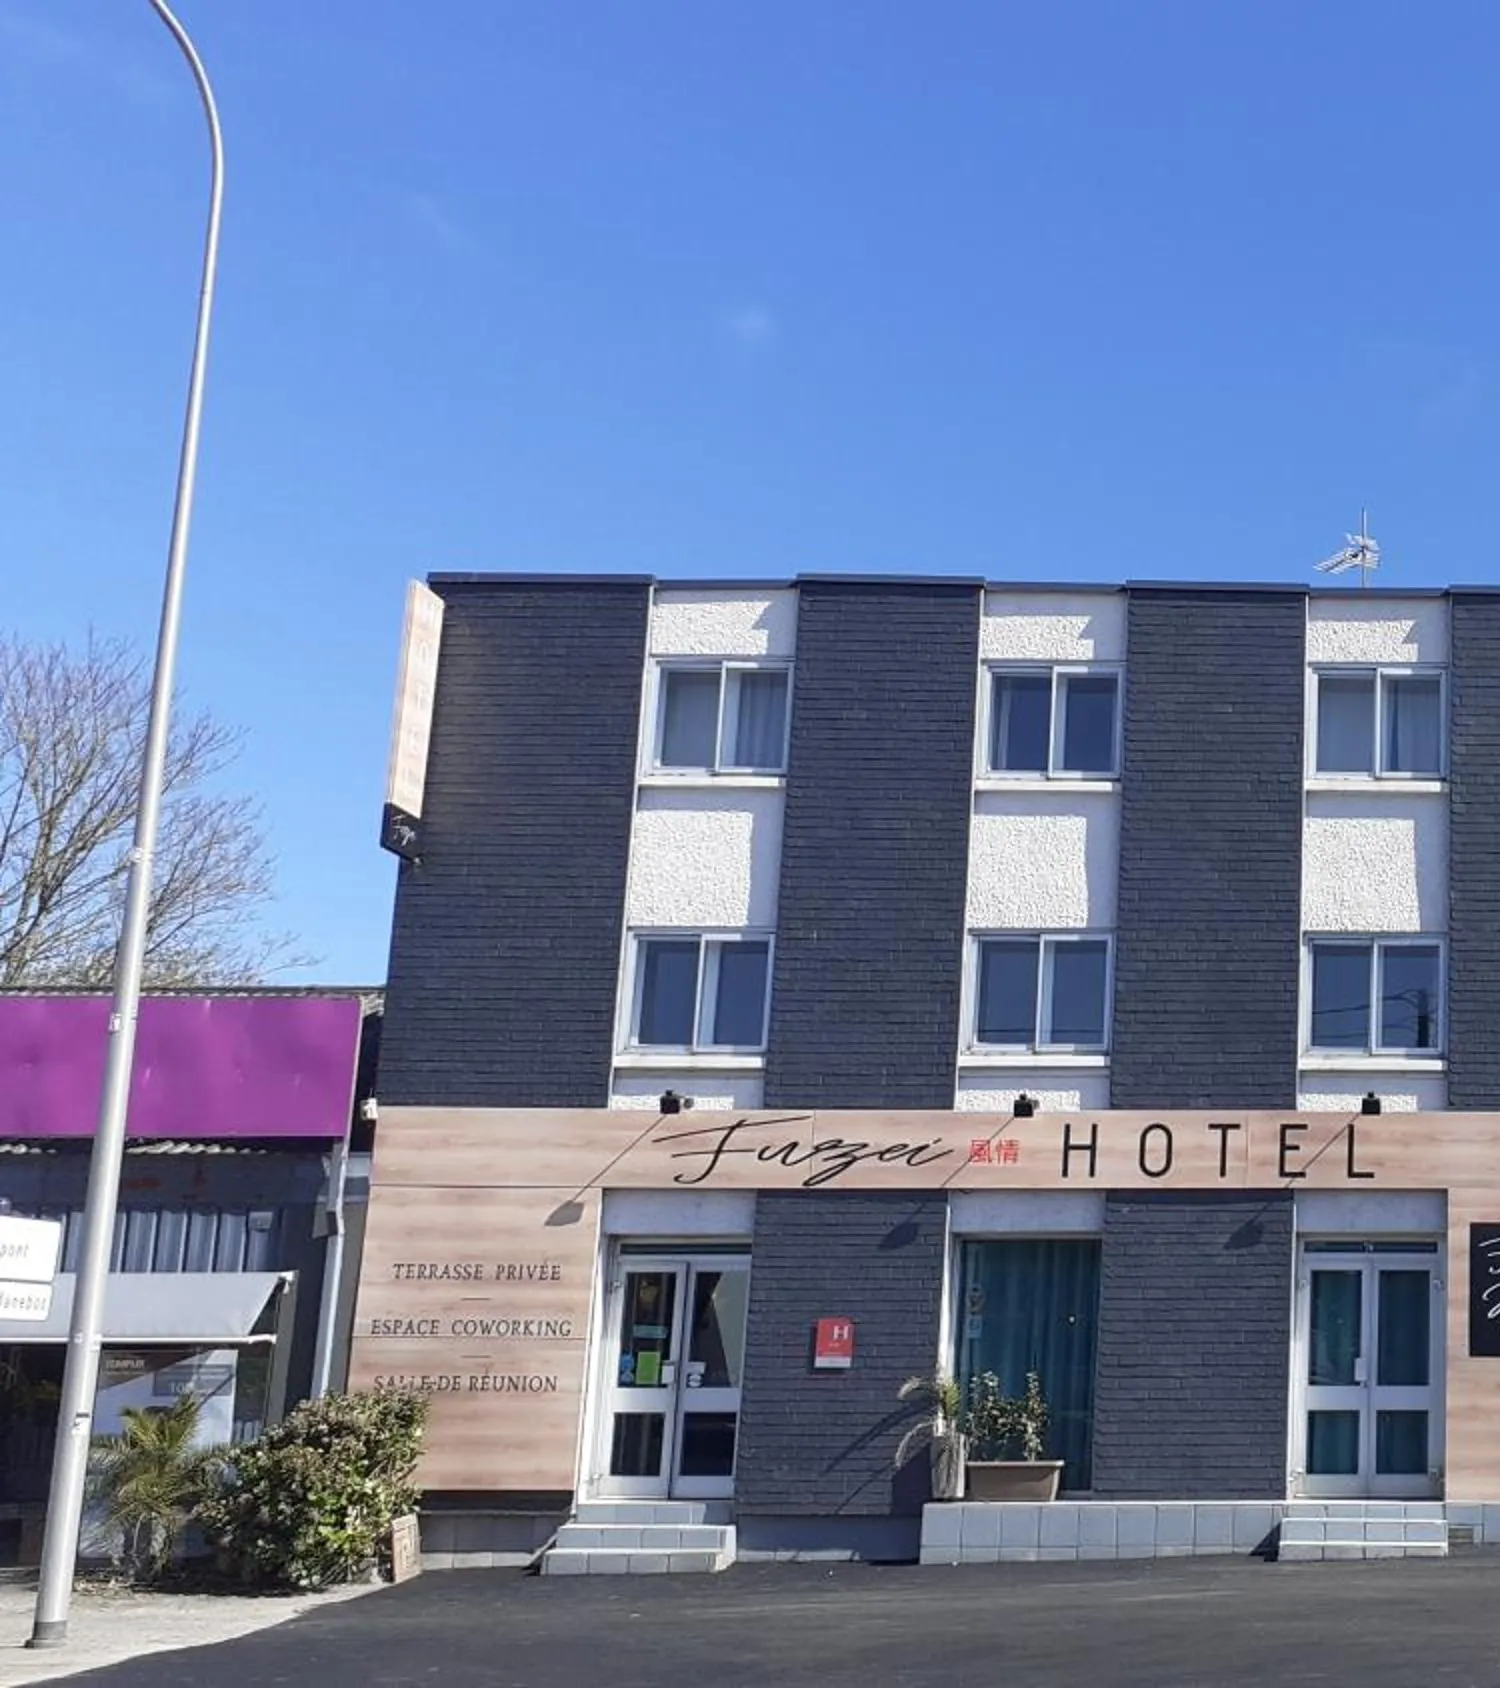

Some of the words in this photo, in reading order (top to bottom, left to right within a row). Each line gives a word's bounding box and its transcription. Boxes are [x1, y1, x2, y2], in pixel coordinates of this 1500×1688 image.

[652, 1115, 954, 1187] Fuzei
[1061, 1123, 1375, 1179] HOTEL
[393, 1263, 485, 1281] TERRASSE
[495, 1258, 561, 1281] PRIVÉE
[371, 1319, 440, 1336] ESPACE
[451, 1319, 573, 1338] COWORKING
[437, 1375, 461, 1392] DE
[469, 1368, 558, 1393] RÉUNION
